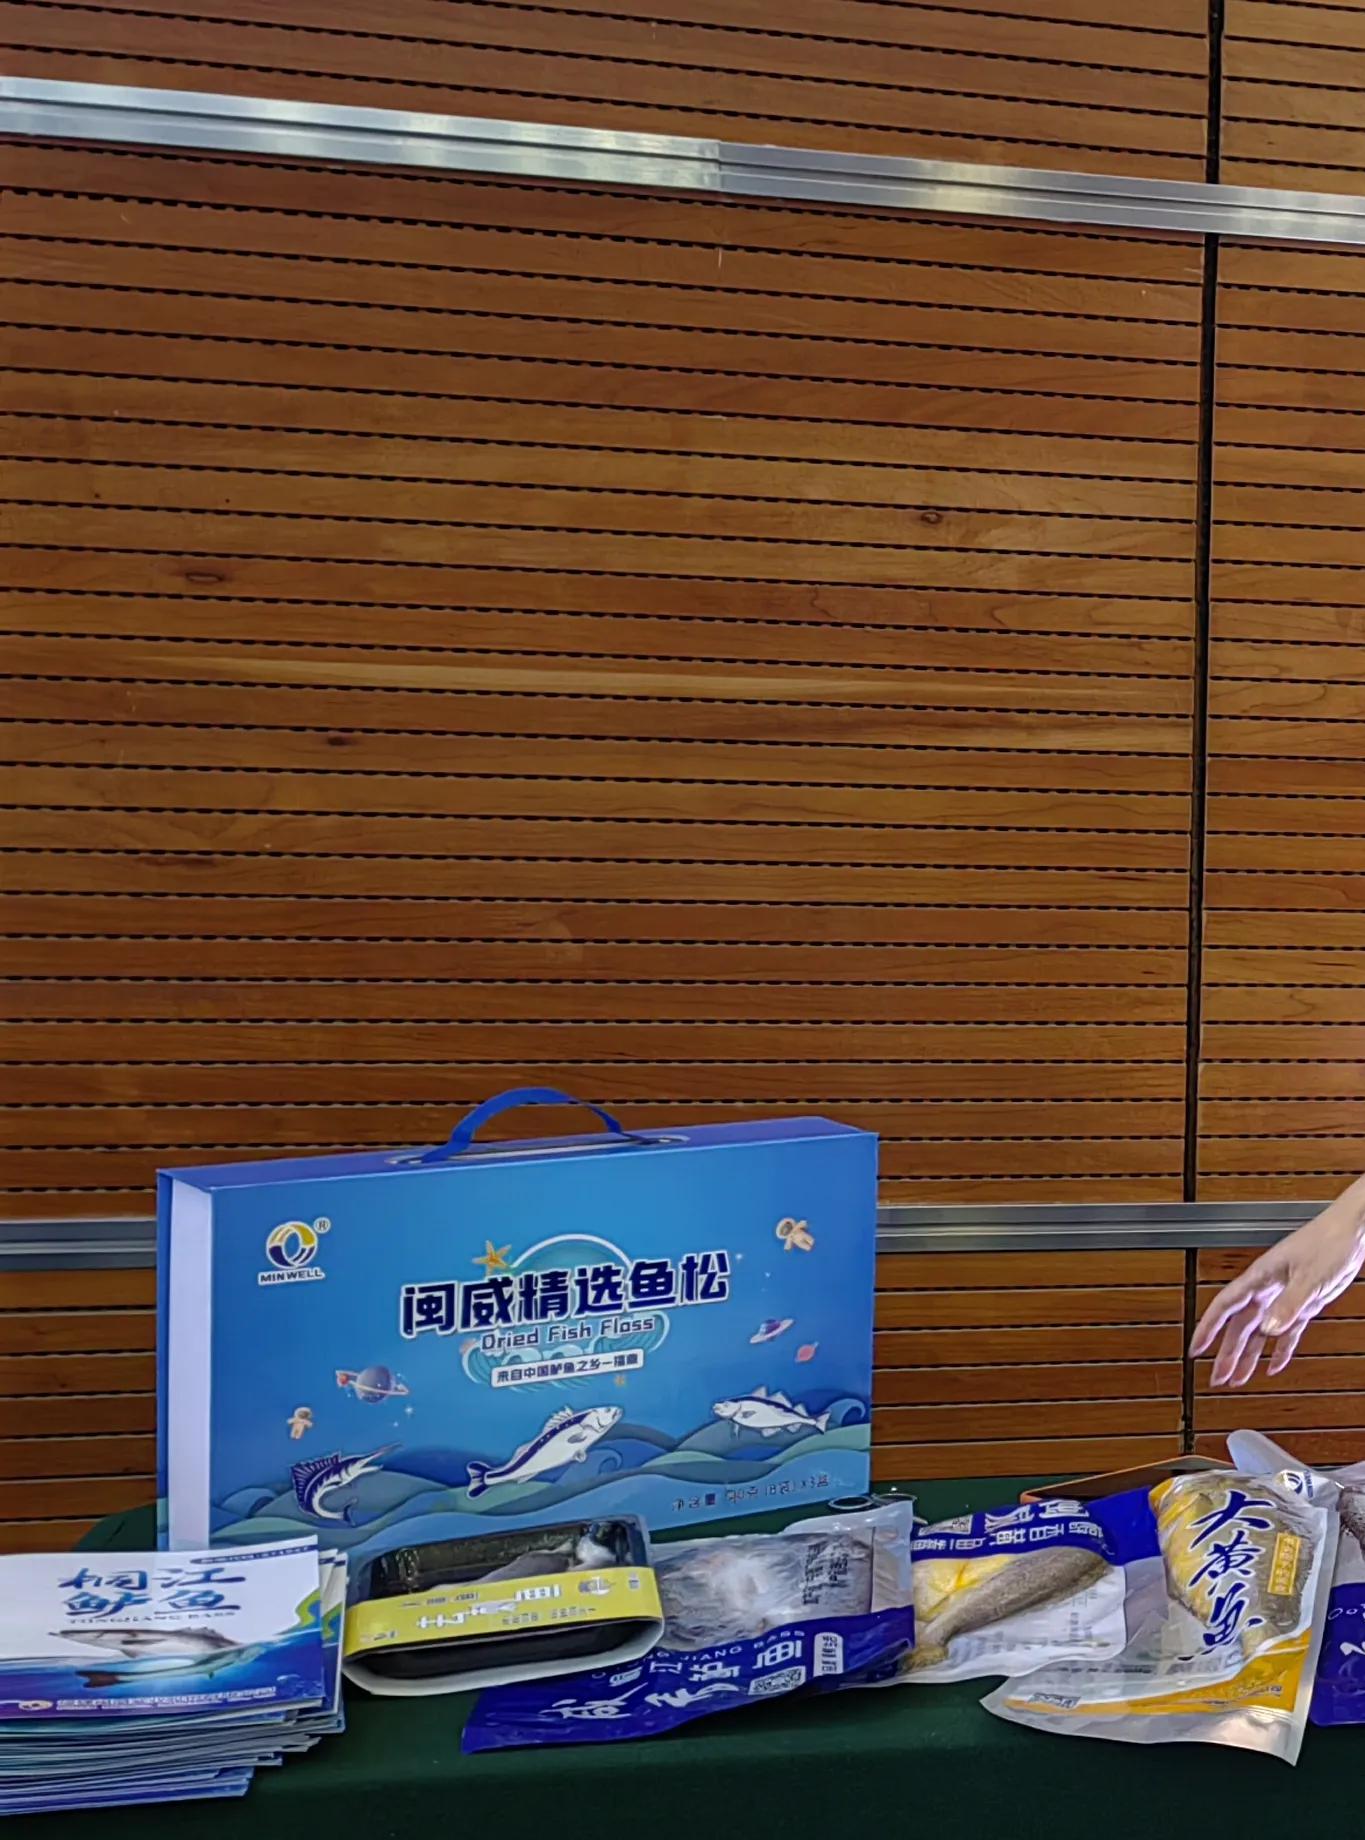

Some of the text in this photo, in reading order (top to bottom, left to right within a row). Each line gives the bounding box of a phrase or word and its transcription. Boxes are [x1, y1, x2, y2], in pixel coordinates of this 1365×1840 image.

[259, 1269, 323, 1284] MINWELL
[402, 1250, 731, 1336] 闽威精选鱼松
[481, 1315, 654, 1351] Dried Fish Floss
[1178, 1490, 1274, 1660] 大黄鱼
